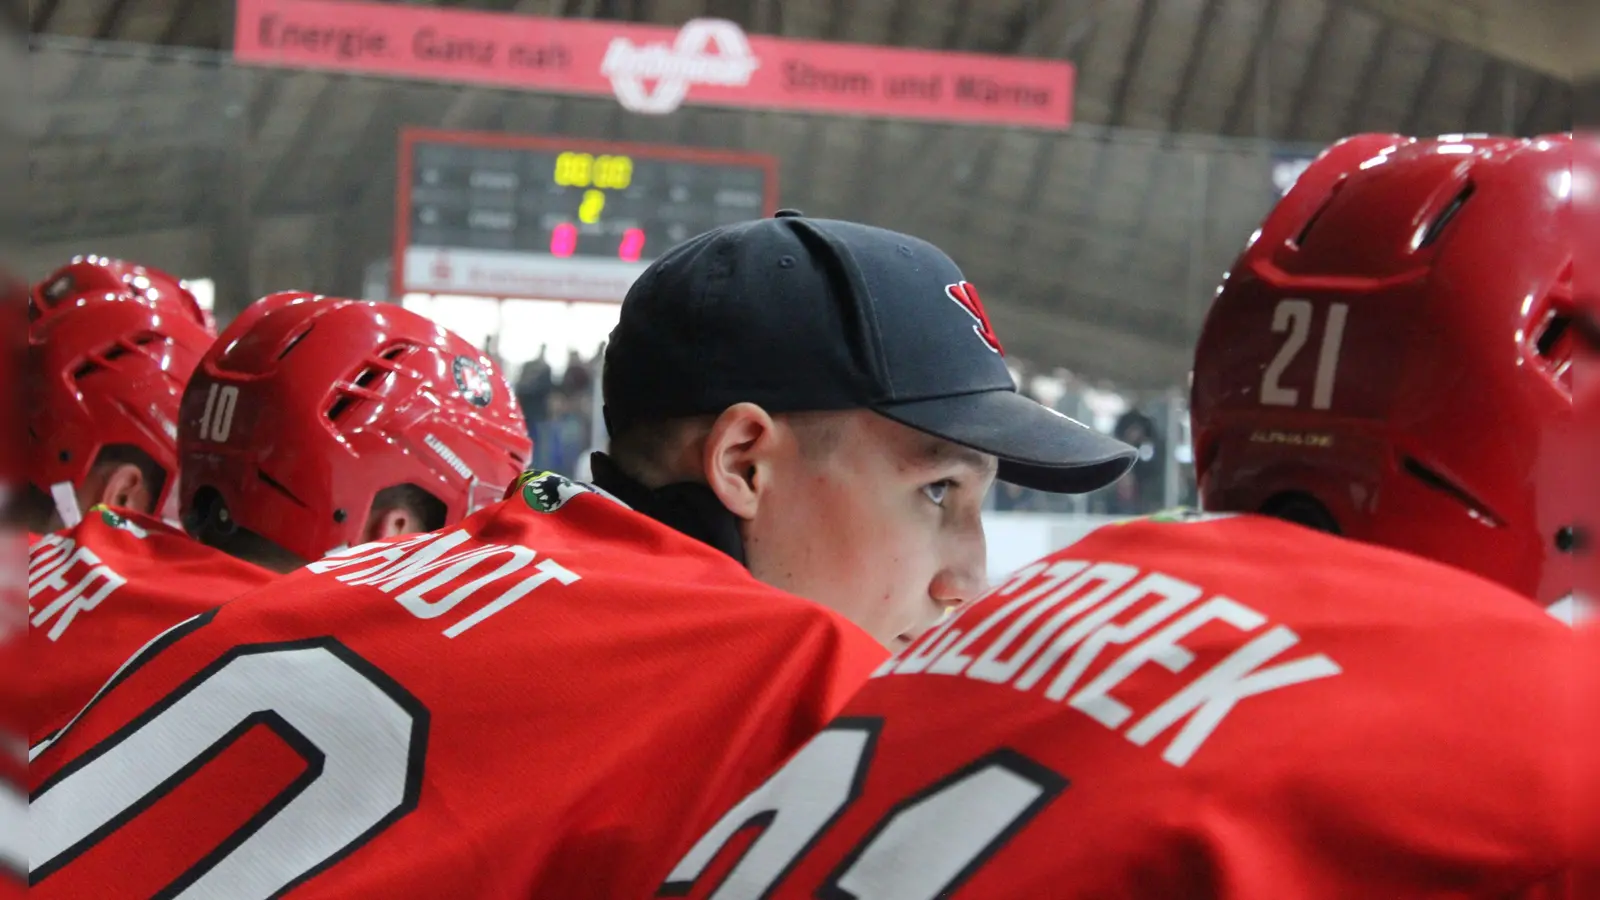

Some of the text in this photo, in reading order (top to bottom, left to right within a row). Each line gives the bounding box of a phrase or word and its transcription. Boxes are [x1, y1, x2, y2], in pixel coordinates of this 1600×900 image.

[411, 25, 495, 62] Ganz
[781, 58, 872, 95] Strom
[884, 73, 942, 101] und
[954, 72, 1052, 108] Wärme
[1259, 298, 1349, 410] 21
[199, 382, 240, 443] 10
